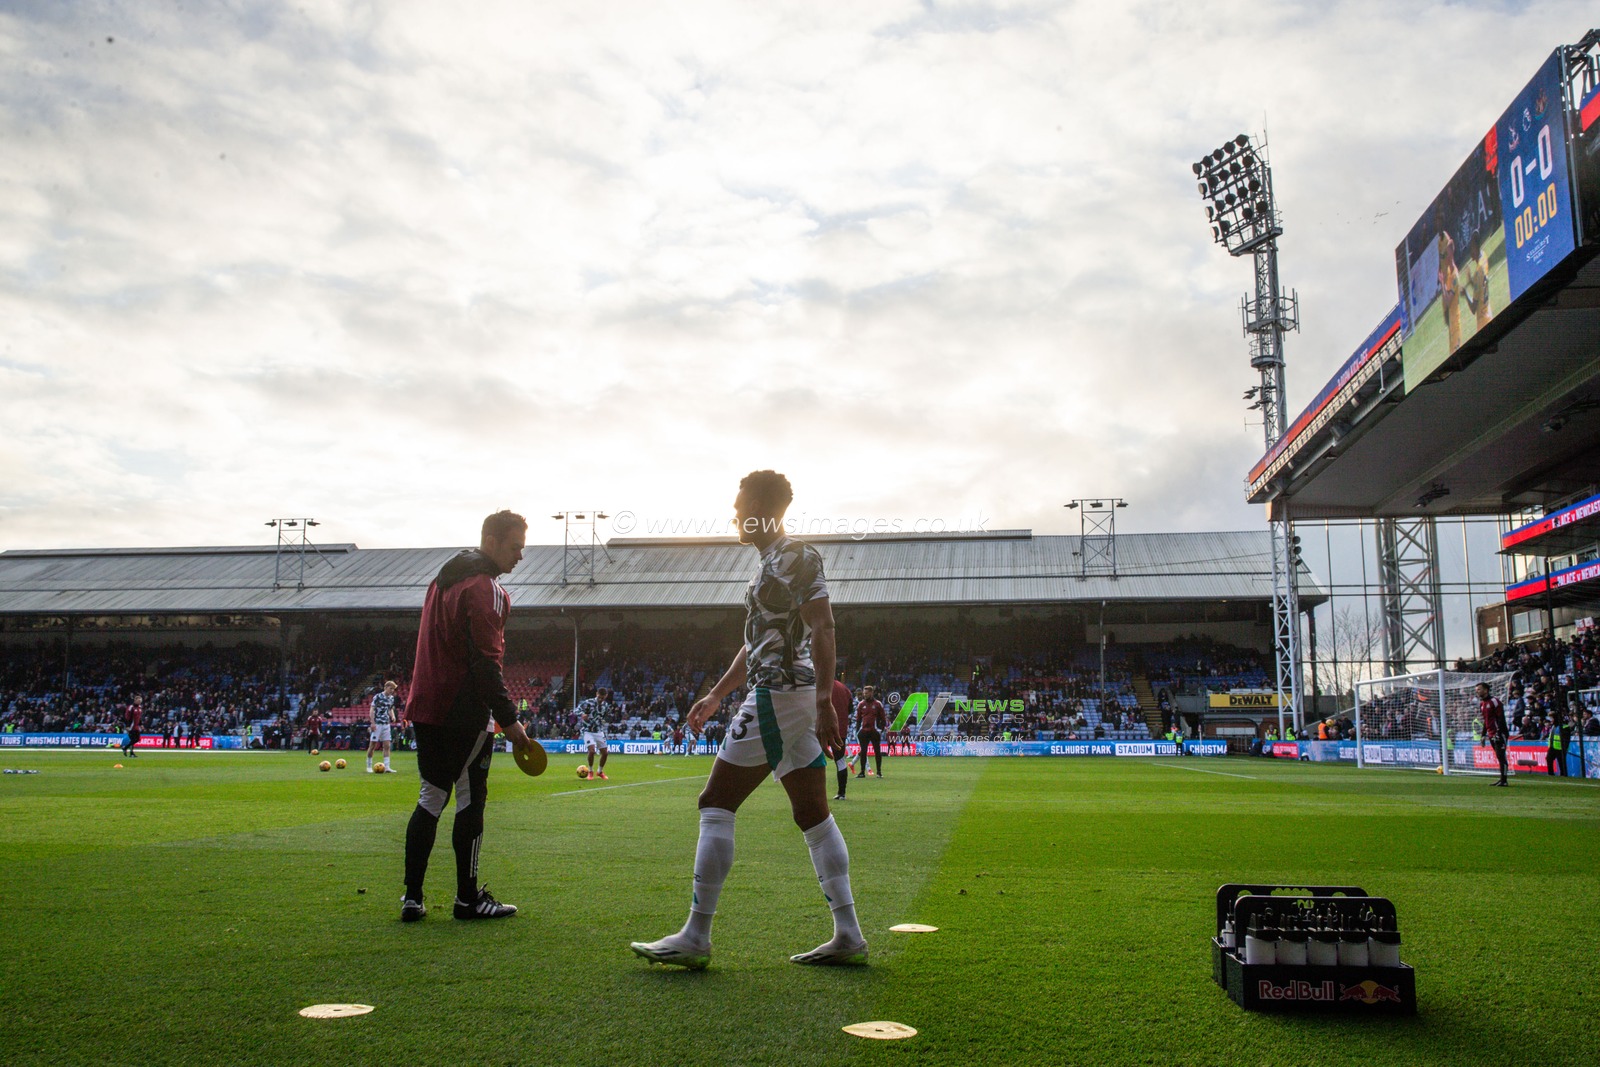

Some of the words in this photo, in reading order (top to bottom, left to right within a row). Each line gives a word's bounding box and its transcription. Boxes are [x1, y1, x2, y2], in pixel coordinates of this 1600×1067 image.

[1515, 182, 1557, 249] 00:00
[731, 711, 754, 740] 3
[1, 736, 21, 745] TOURS
[25, 736, 60, 745] CHRISTMAS
[60, 736, 80, 745] DATES
[81, 737, 90, 745] ON
[91, 737, 107, 745] SALE
[108, 737, 123, 746] NOW
[626, 744, 658, 753] STADIUM
[1050, 745, 1089, 754] SELHURST
[1091, 745, 1111, 754] PARK
[1118, 745, 1153, 754] STADIUM
[1258, 980, 1296, 999] Red
[1297, 981, 1334, 1000] Bull
